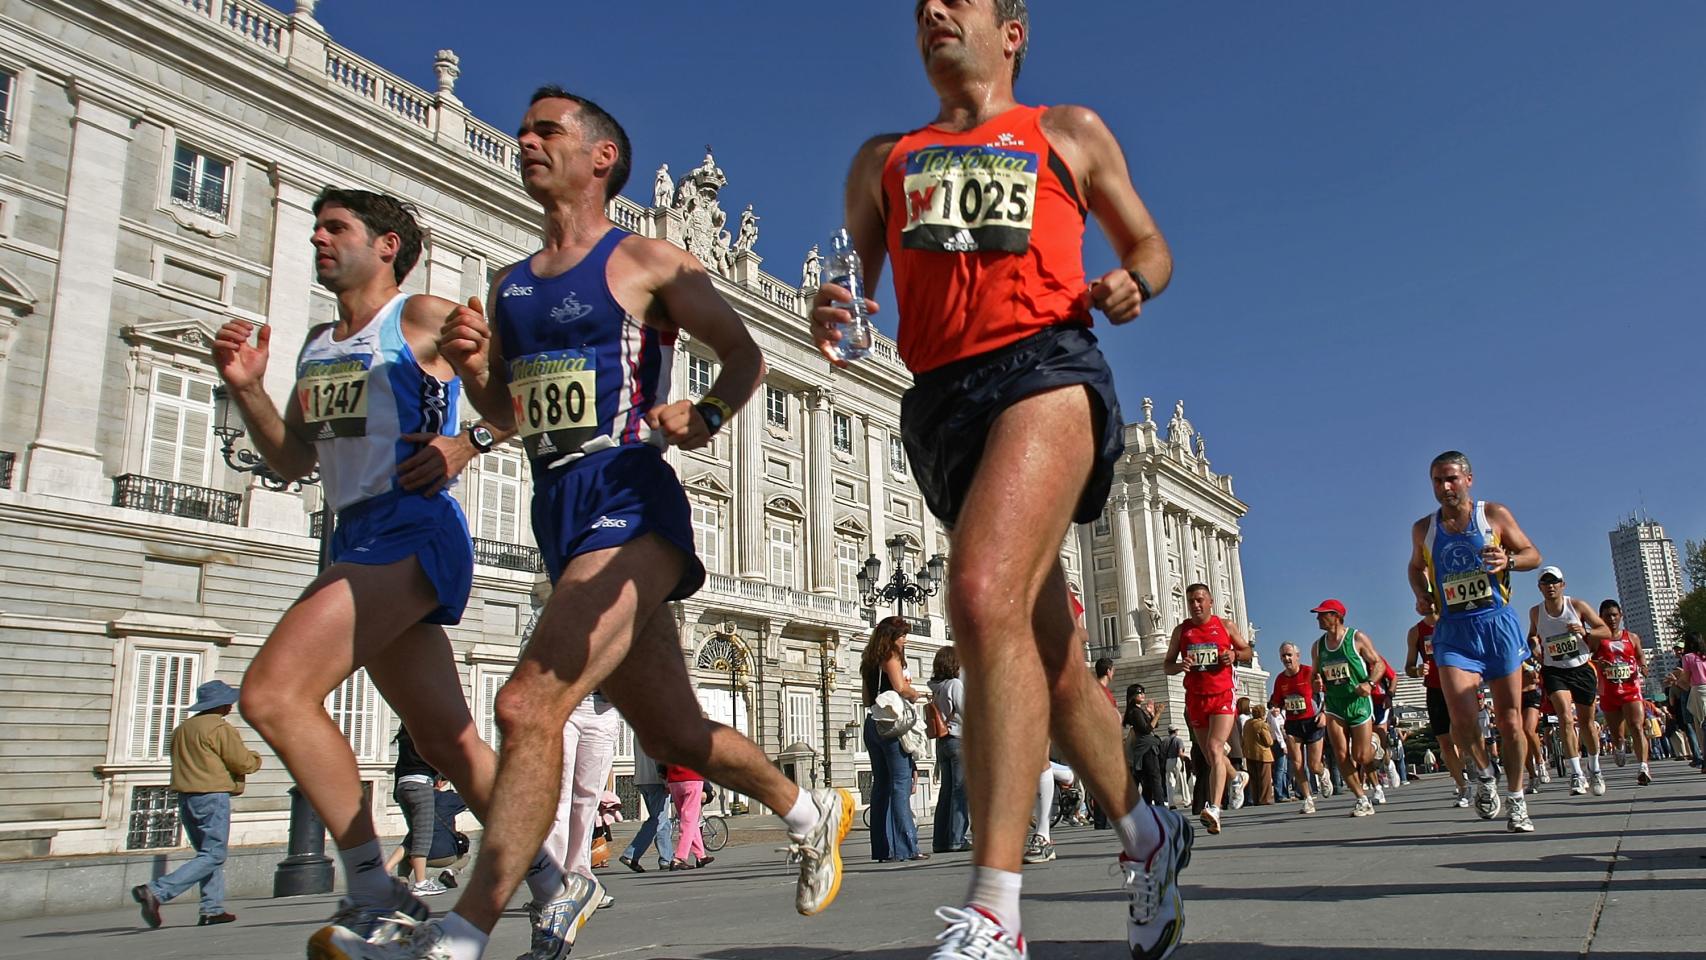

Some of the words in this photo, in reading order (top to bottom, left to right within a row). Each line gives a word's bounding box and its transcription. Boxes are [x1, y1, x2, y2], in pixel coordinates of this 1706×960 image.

[941, 178, 1028, 223] 1025
[314, 380, 365, 418] 1247
[528, 381, 586, 428] 680
[1457, 579, 1487, 601] 949
[1196, 651, 1218, 664] 1713
[1556, 640, 1577, 654] 8087
